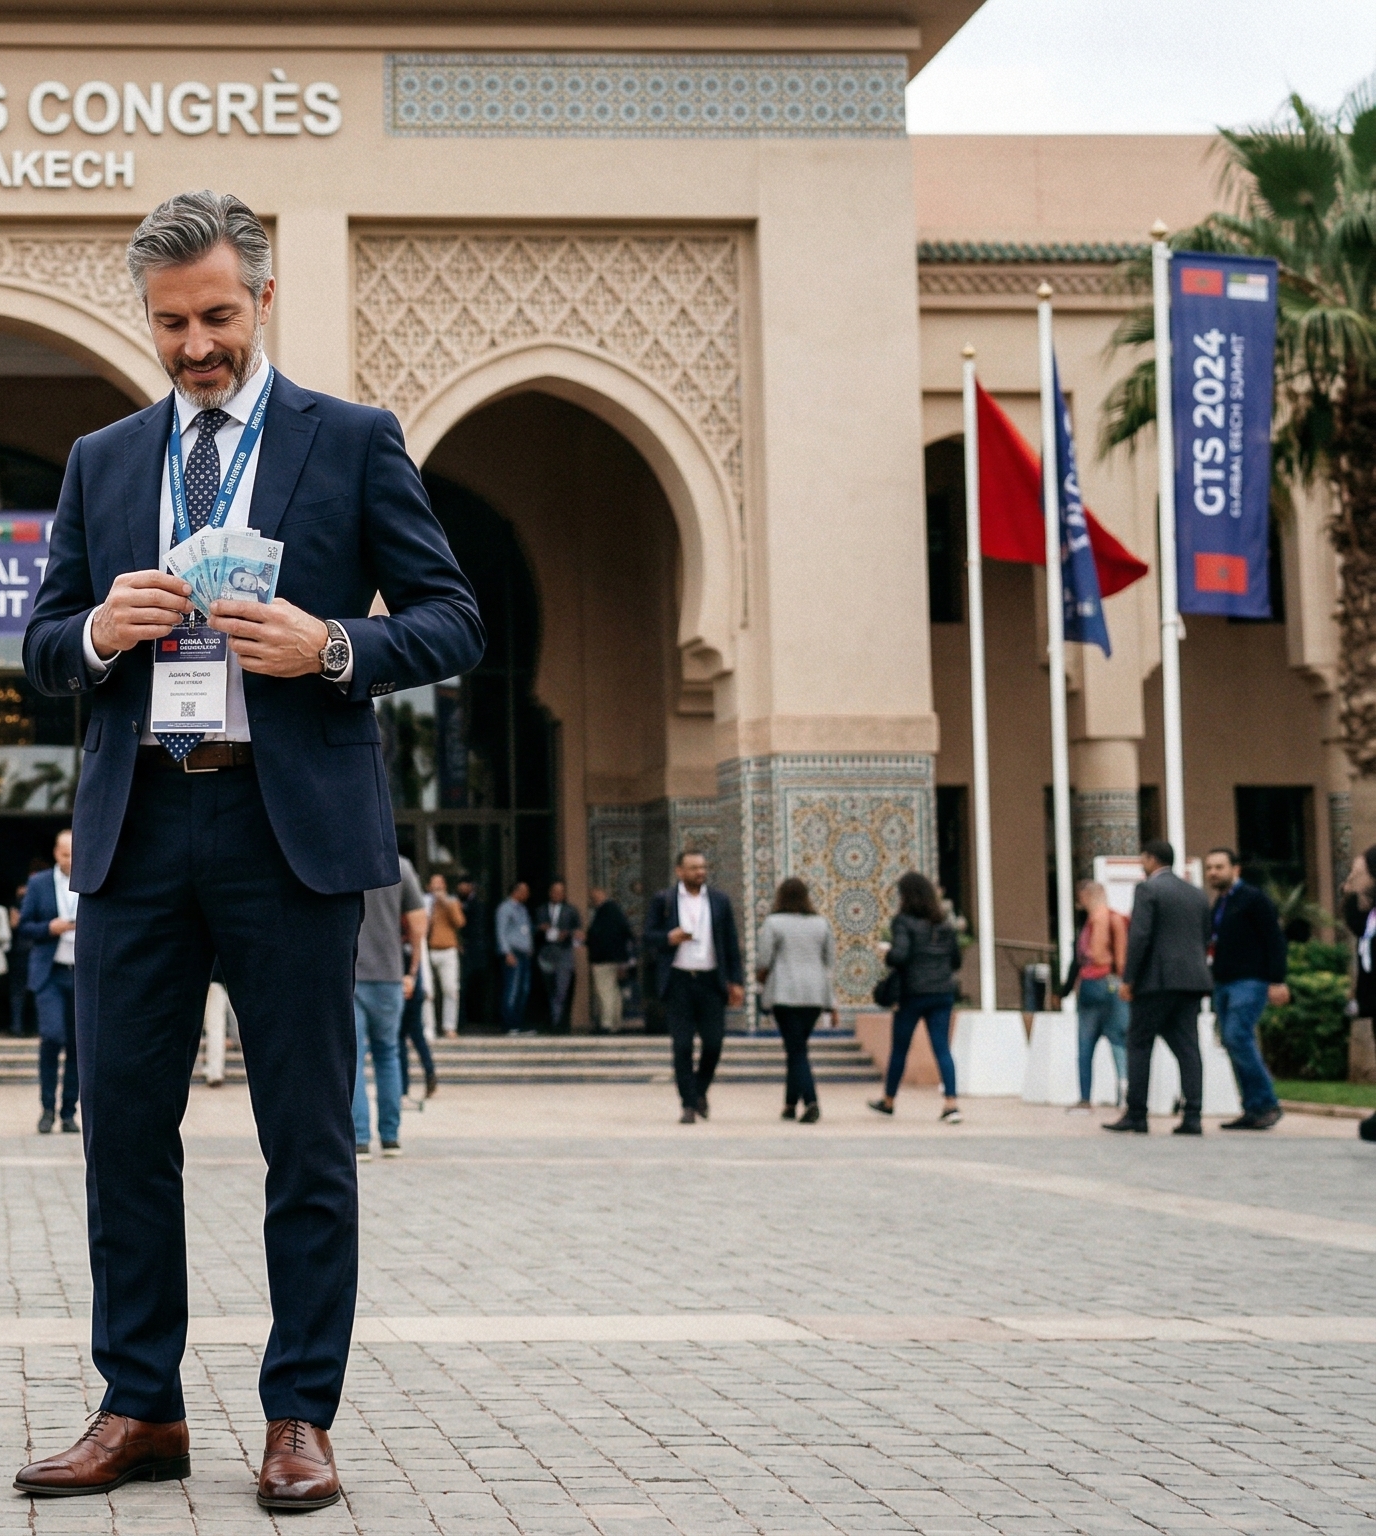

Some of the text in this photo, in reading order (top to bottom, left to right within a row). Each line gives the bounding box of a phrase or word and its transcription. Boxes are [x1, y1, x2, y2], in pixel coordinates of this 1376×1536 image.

[30, 69, 343, 134] CONGRÈS
[1193, 329, 1227, 517] GTS 2024
